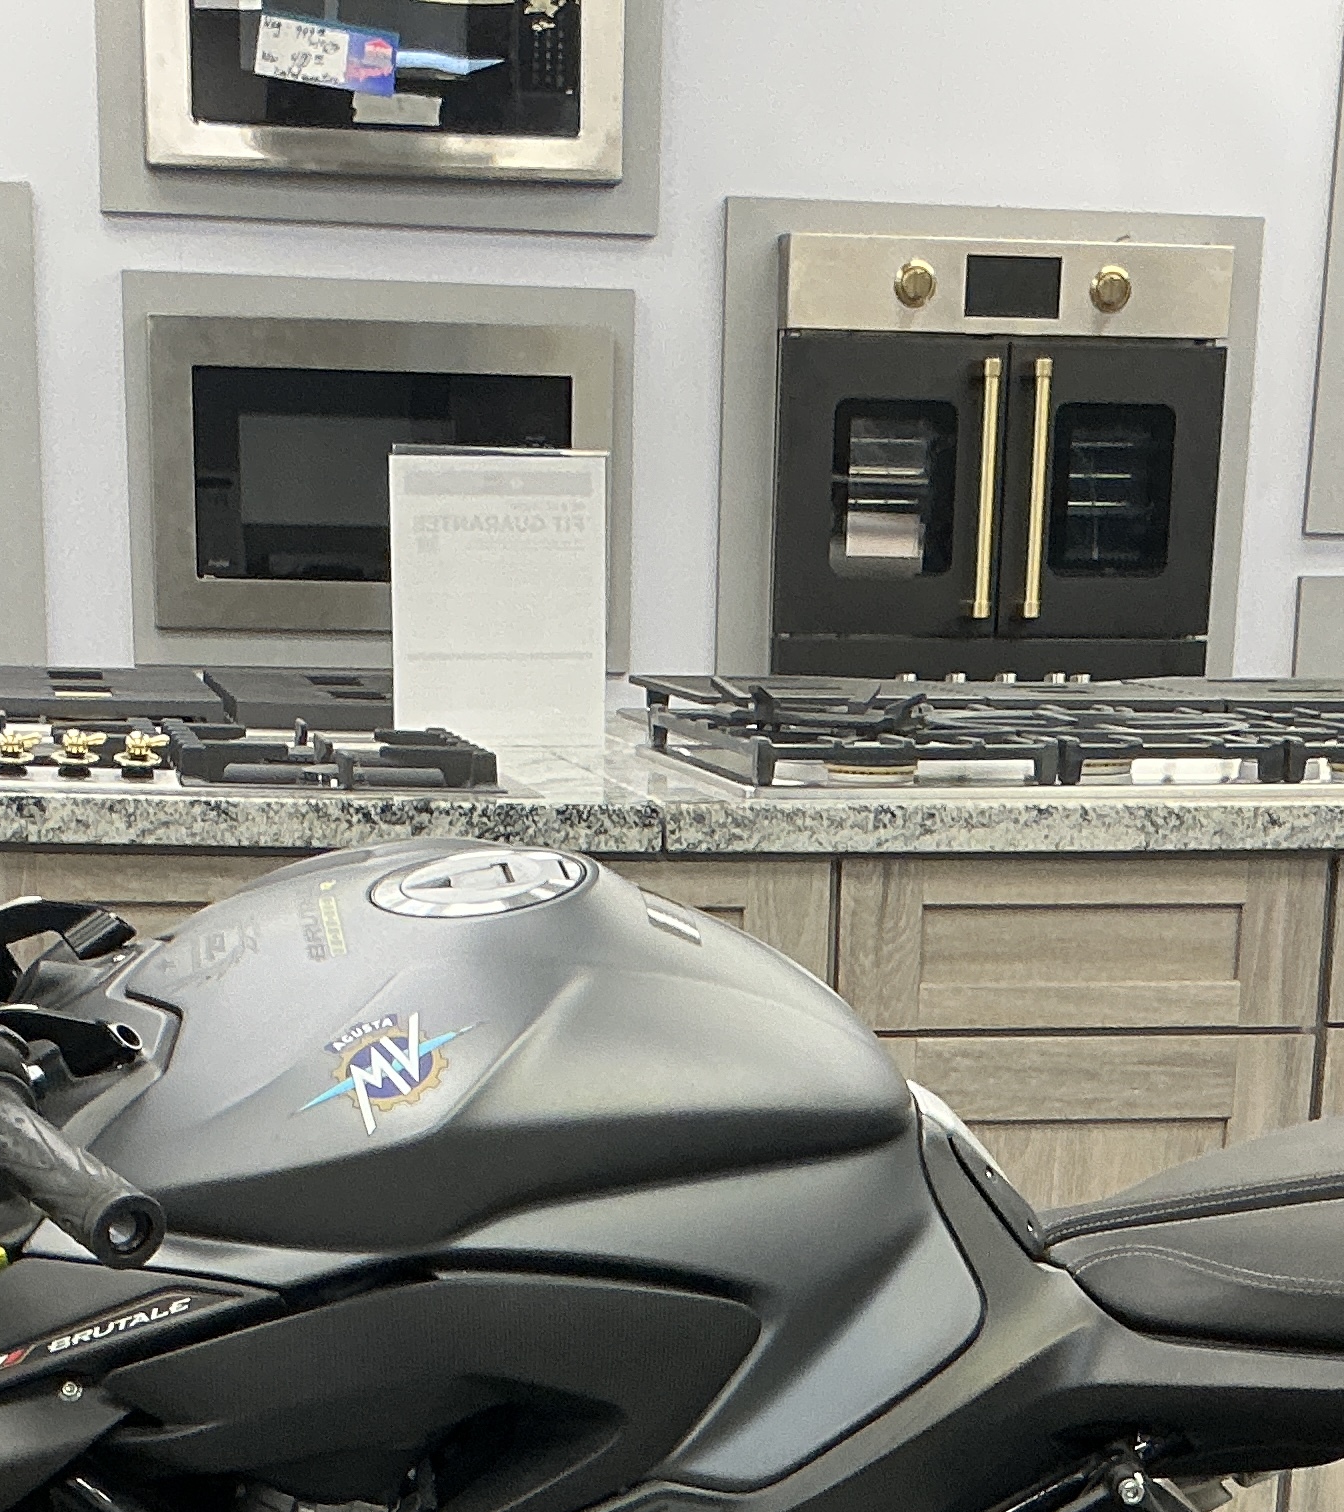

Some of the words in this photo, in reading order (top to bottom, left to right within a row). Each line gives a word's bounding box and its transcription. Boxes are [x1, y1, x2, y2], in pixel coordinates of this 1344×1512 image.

[332, 1017, 393, 1052] AGUSTA
[349, 1011, 420, 1136] MV
[47, 1297, 192, 1354] BRUTALE
